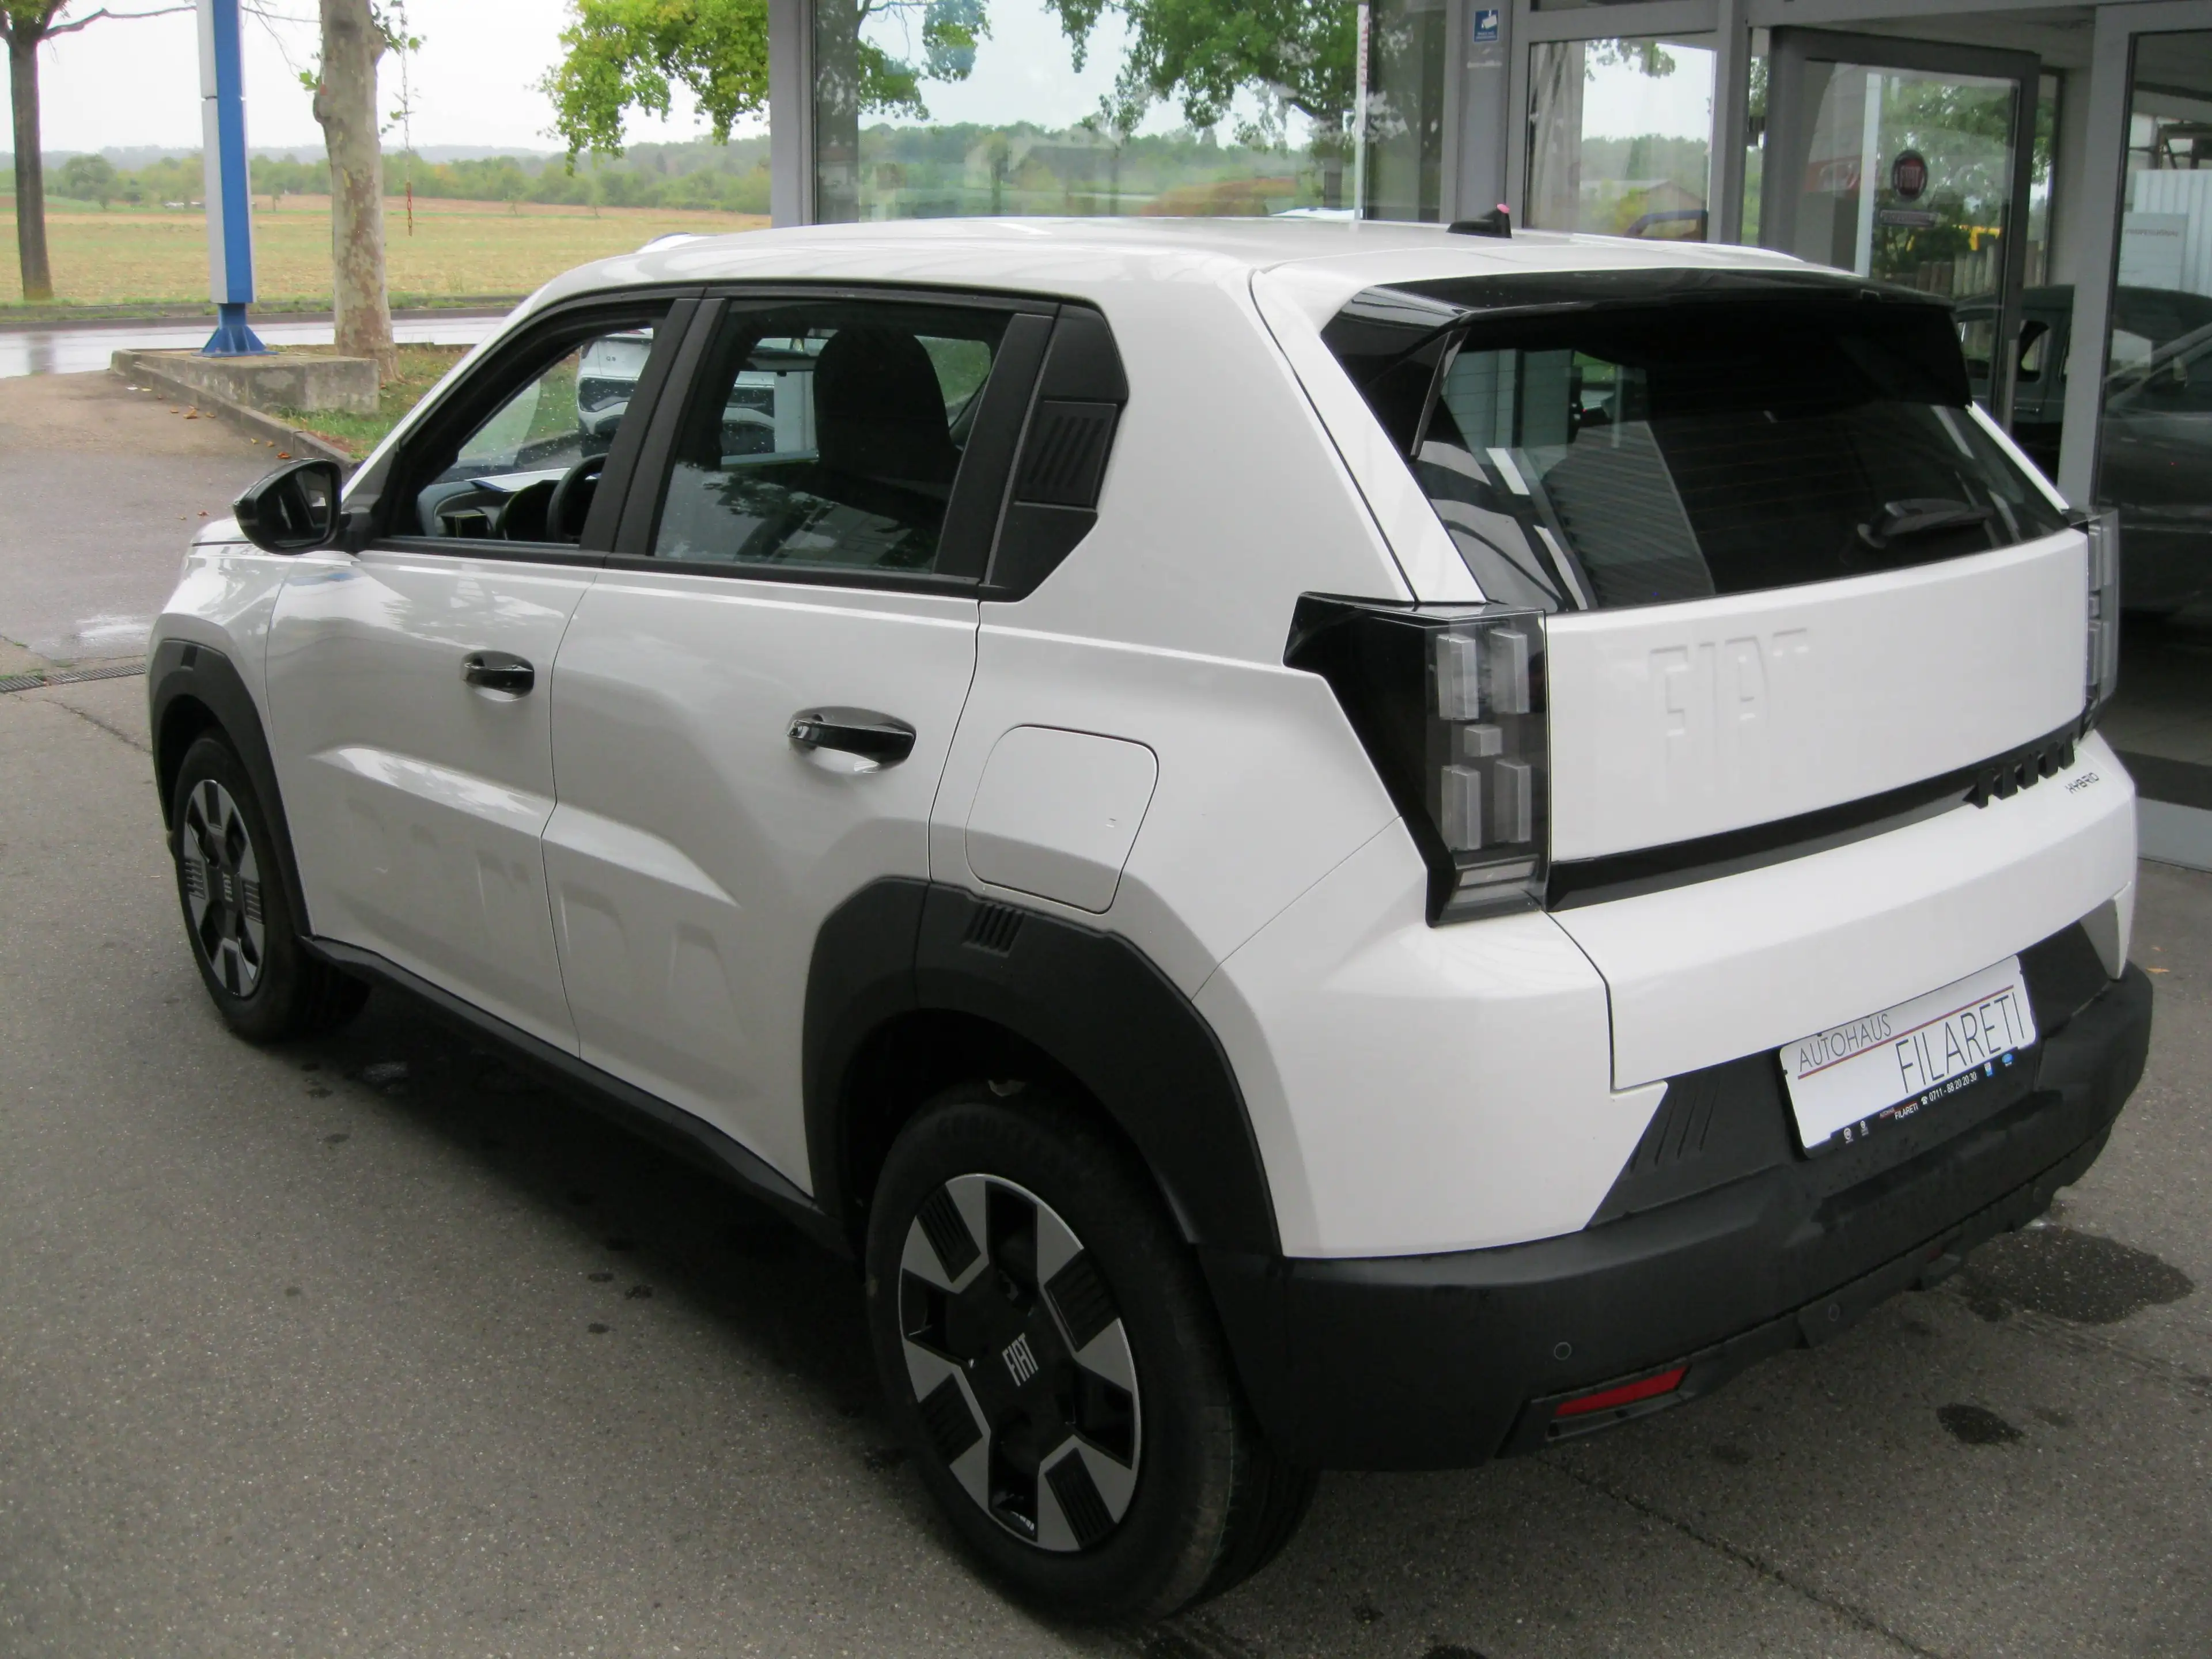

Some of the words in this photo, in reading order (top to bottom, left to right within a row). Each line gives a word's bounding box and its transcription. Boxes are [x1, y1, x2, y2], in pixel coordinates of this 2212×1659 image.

[2065, 772, 2100, 794] HYBRID
[221, 871, 234, 902] FIAT
[1798, 1013, 1892, 1072] AUTOHAUS
[1895, 991, 2025, 1094] FILARETI
[1928, 1088, 1943, 1102] 0711
[1946, 1082, 1955, 1094] 88
[1955, 1078, 1963, 1090] 20
[1962, 1075, 1970, 1086] 20
[1969, 1071, 1978, 1082] 30
[1894, 1102, 1919, 1120] FILARETI
[1001, 1332, 1039, 1387] FIAT
